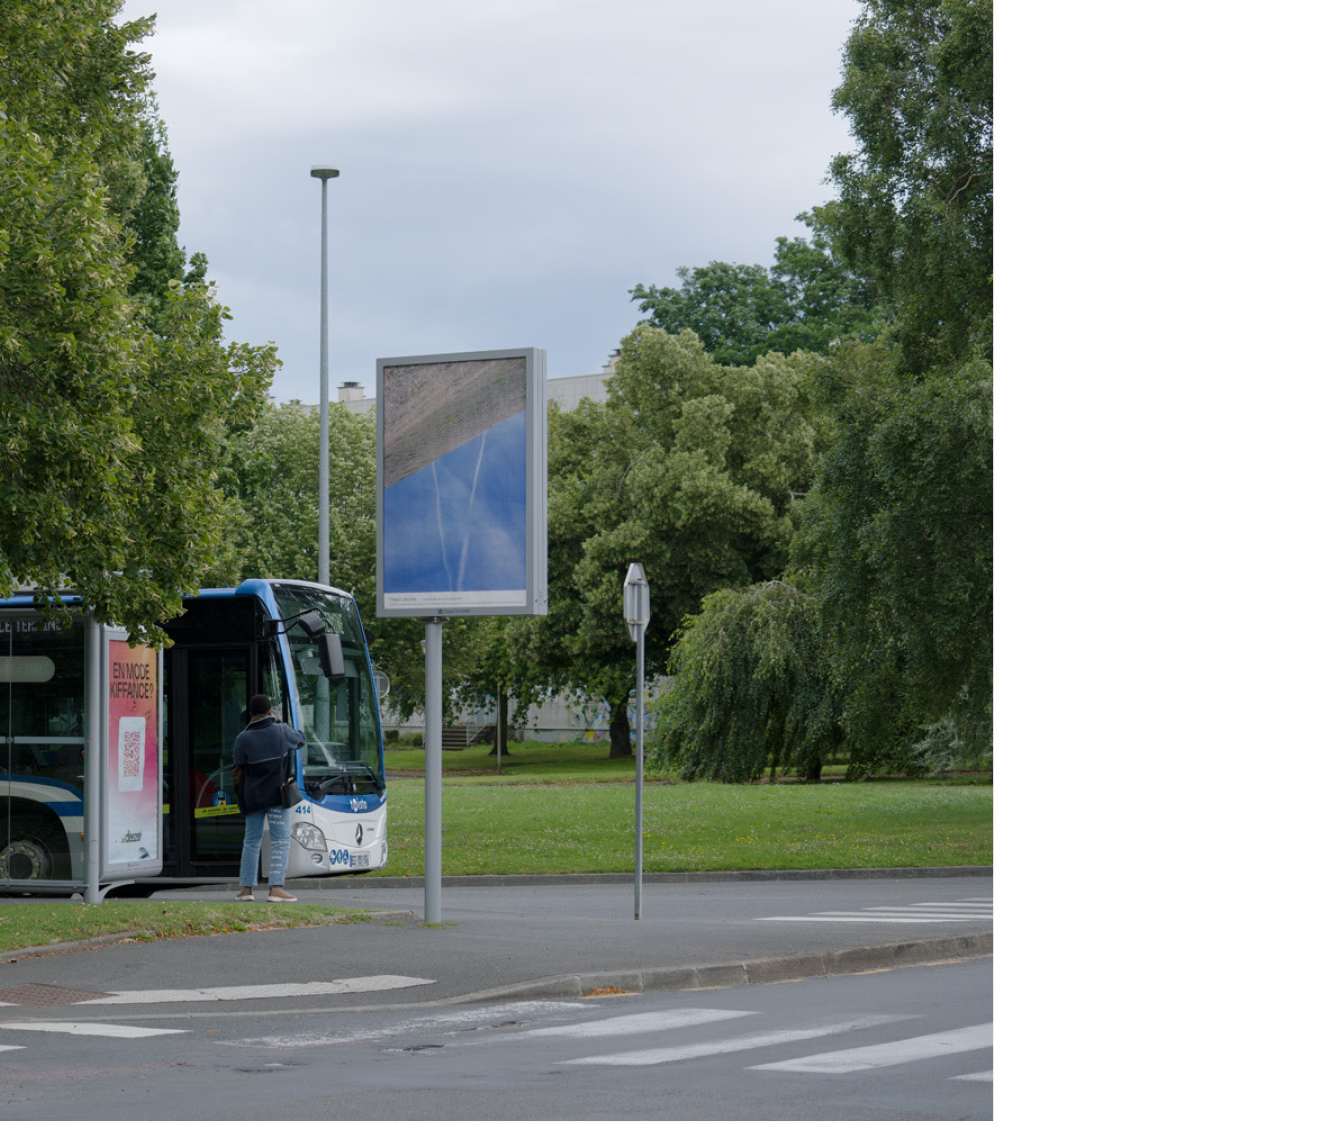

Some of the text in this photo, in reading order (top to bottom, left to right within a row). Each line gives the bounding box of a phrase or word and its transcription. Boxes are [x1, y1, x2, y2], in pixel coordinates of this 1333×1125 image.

[113, 662, 150, 680] EN MODE
[295, 805, 311, 814] 414
